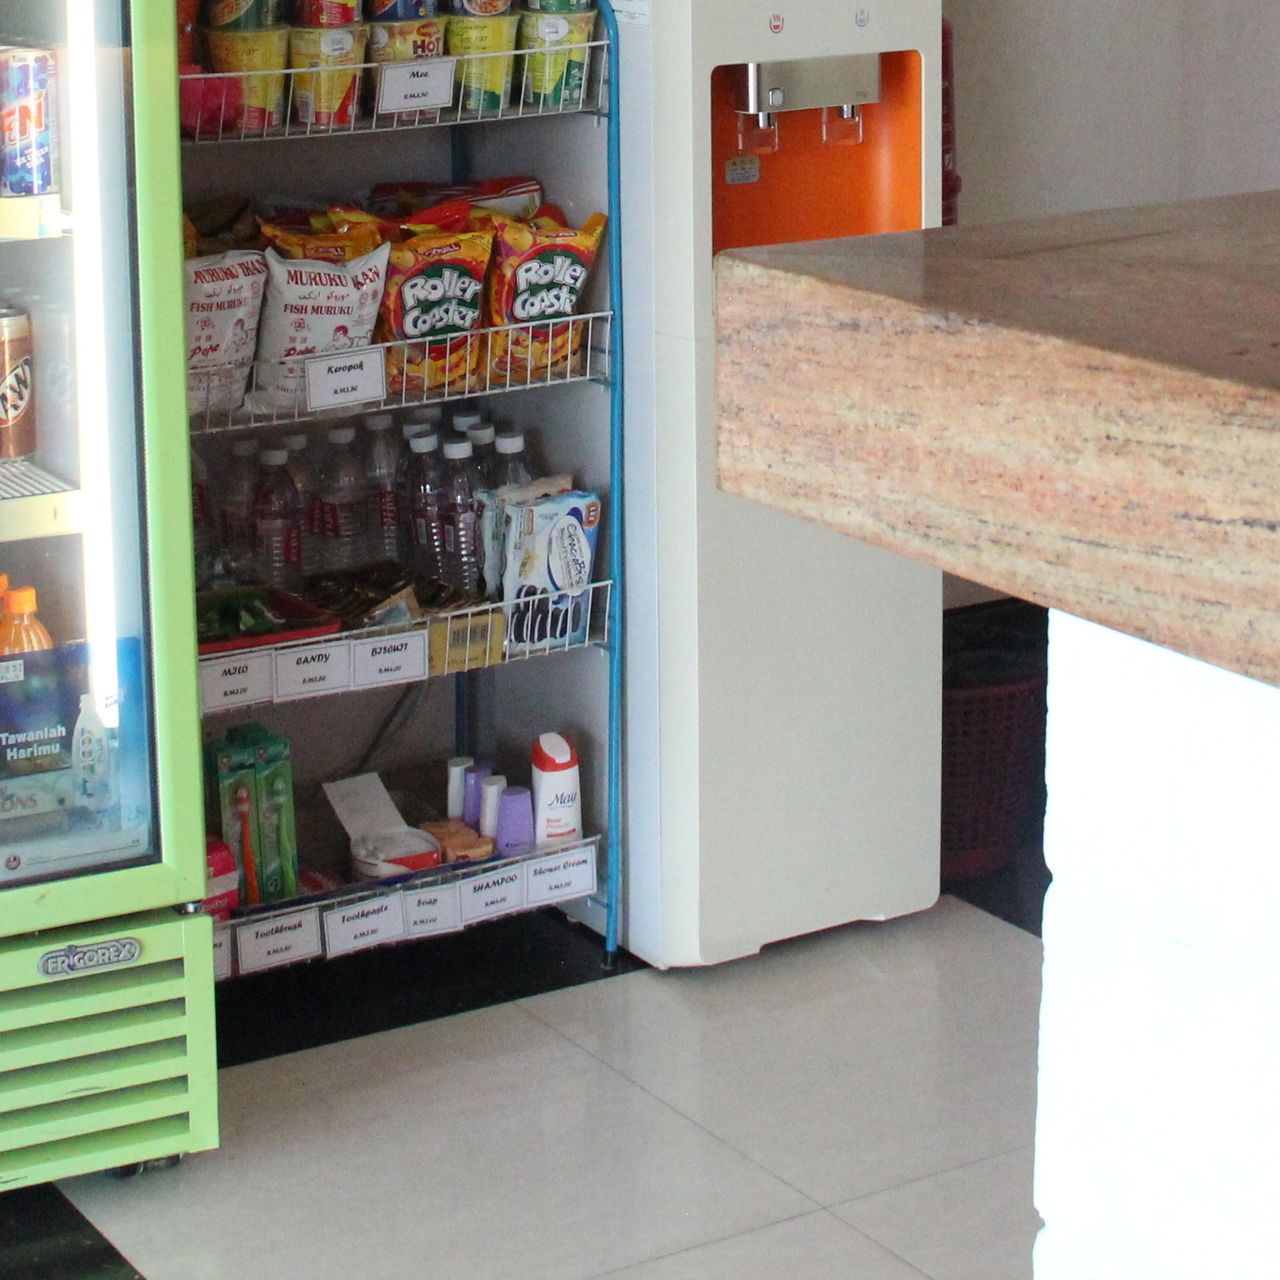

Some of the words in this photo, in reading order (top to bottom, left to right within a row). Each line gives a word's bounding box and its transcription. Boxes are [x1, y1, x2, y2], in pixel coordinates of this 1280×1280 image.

[286, 269, 348, 288] MURUKU
[401, 268, 482, 310] Roller
[190, 301, 215, 312] FISH
[283, 304, 308, 314] FISH
[310, 305, 353, 315] MURUKU
[403, 299, 480, 337] Coaster
[296, 653, 331, 666] CANDY
[6, 742, 60, 761] Harimu
[548, 792, 577, 808] May
[472, 874, 518, 893] SHAMPOO
[416, 897, 438, 907] Soap
[341, 904, 388, 924] Toothpaste
[254, 920, 303, 940] Toothbrush
